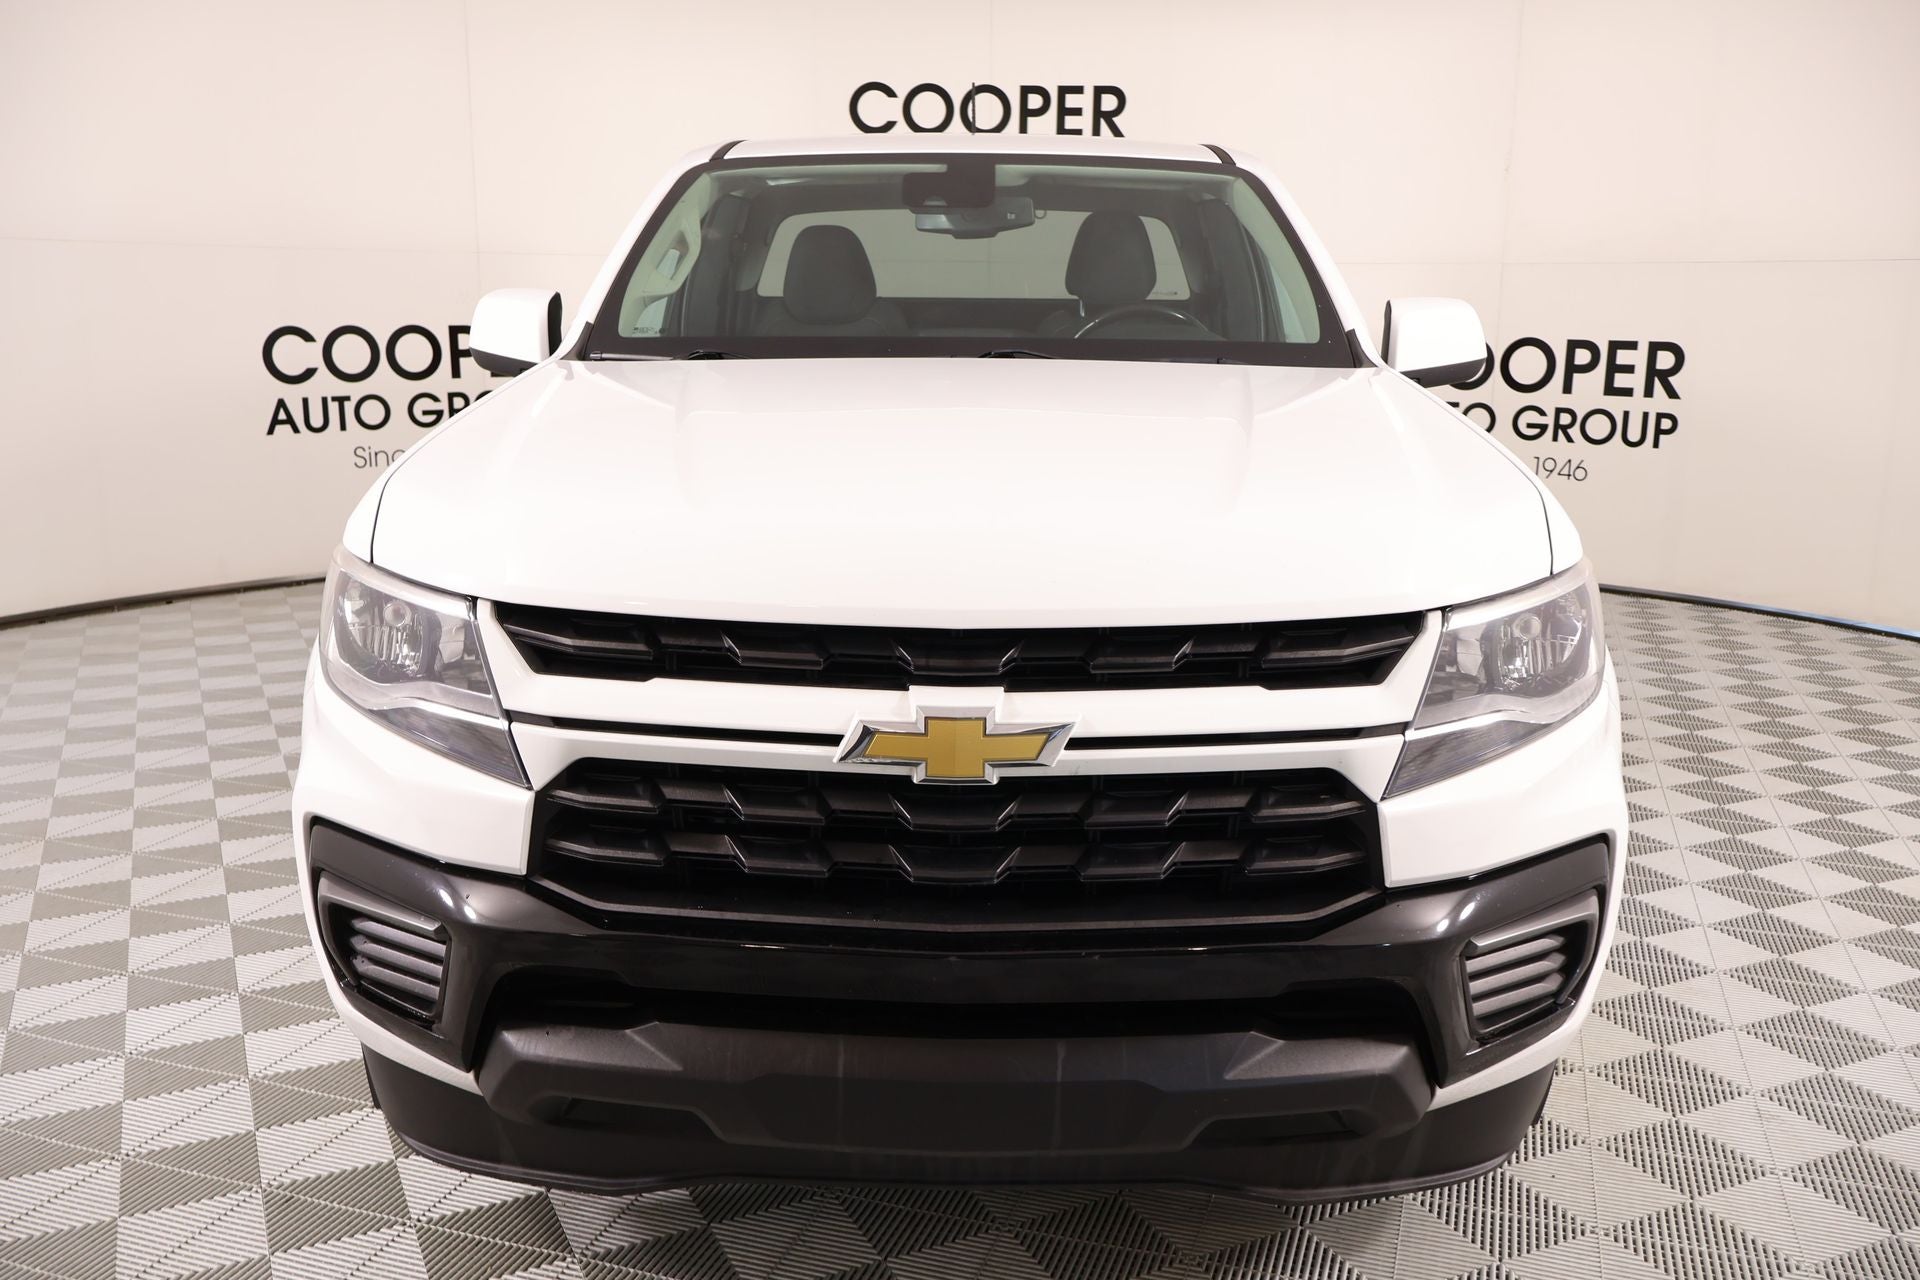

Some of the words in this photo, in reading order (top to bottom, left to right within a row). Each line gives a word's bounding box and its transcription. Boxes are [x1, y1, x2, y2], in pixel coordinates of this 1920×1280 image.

[849, 81, 1127, 138] COOPER
[262, 324, 514, 385] COOP
[1448, 336, 1686, 400] OPER
[266, 394, 392, 436] AUTO
[1512, 405, 1679, 449] GROUP
[353, 445, 406, 469] Sin
[1533, 456, 1588, 482] 1946
